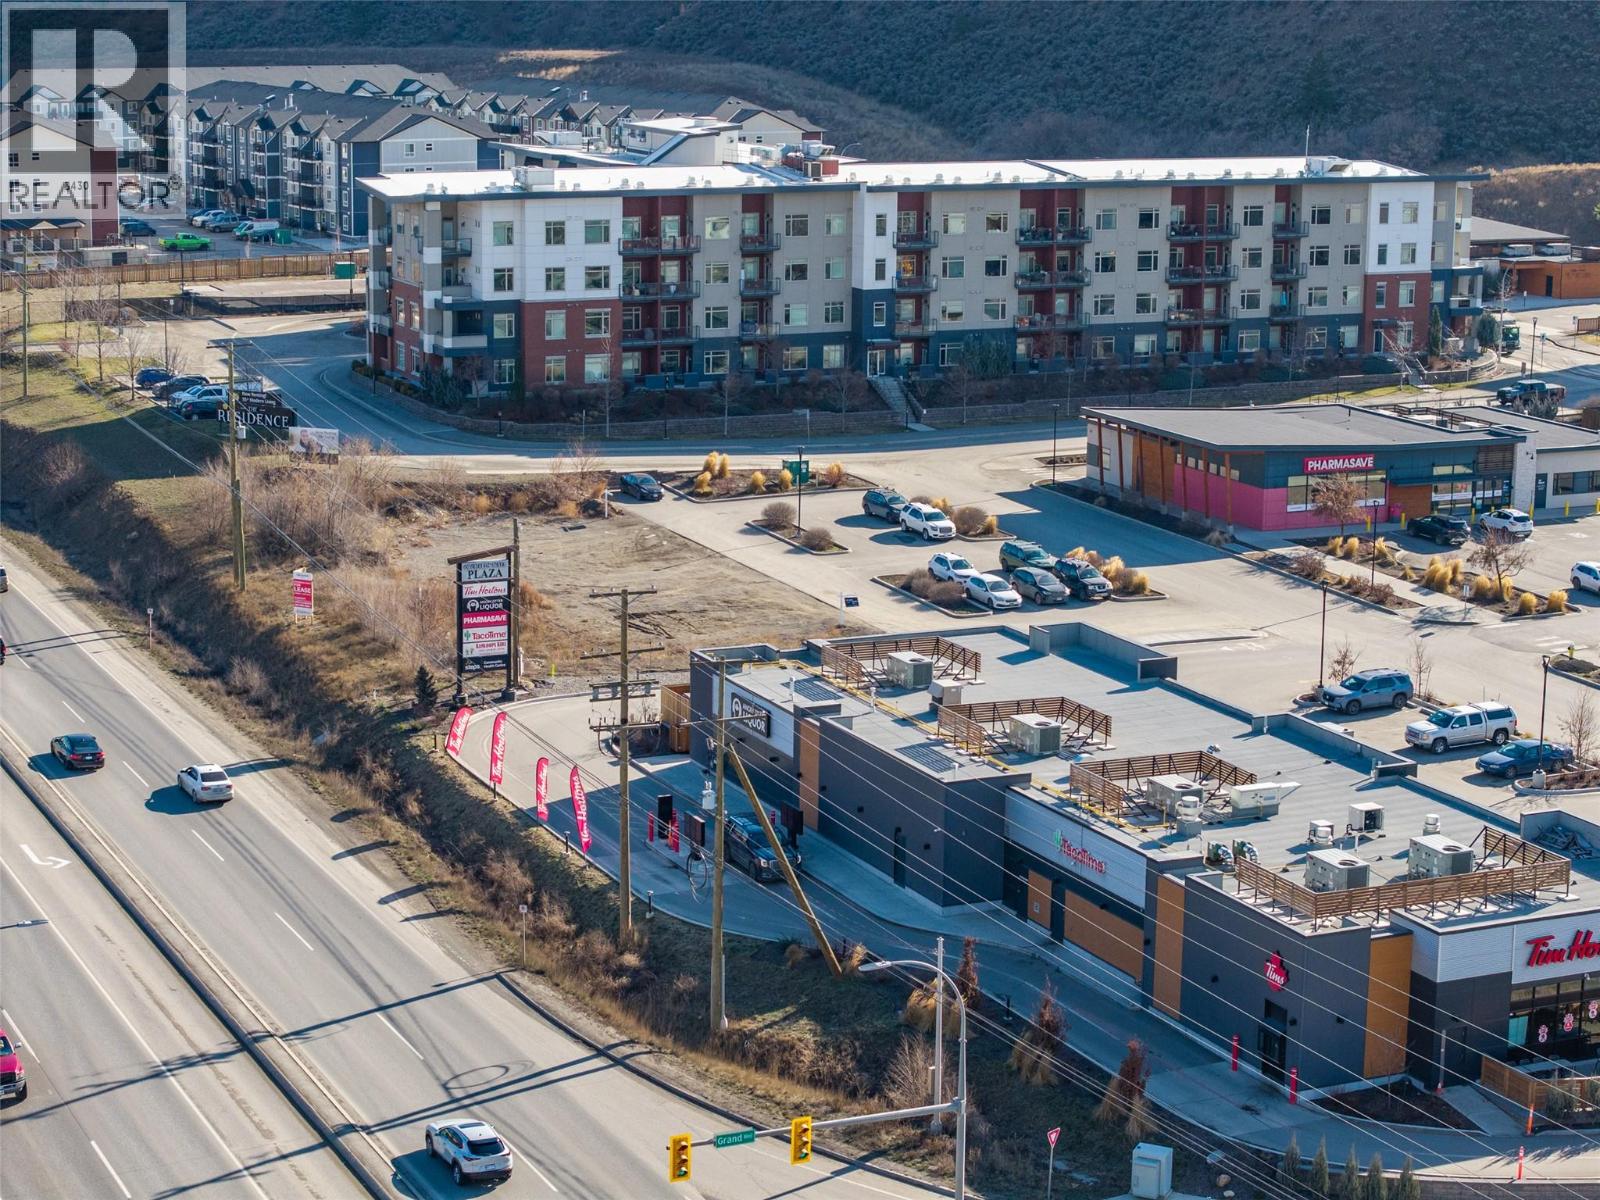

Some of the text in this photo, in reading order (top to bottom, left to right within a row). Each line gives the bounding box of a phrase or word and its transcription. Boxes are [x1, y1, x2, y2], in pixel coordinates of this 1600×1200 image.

[1308, 457, 1374, 471] PHARMASAVE
[468, 569, 503, 579] PLAZA
[464, 585, 506, 597] Tim Hortons
[463, 615, 507, 624] PHARMASAVE
[472, 631, 506, 640] TacoTime
[1526, 929, 1600, 967] Tim Ho
[1265, 962, 1285, 985] Tims
[717, 1134, 743, 1145] Grand
